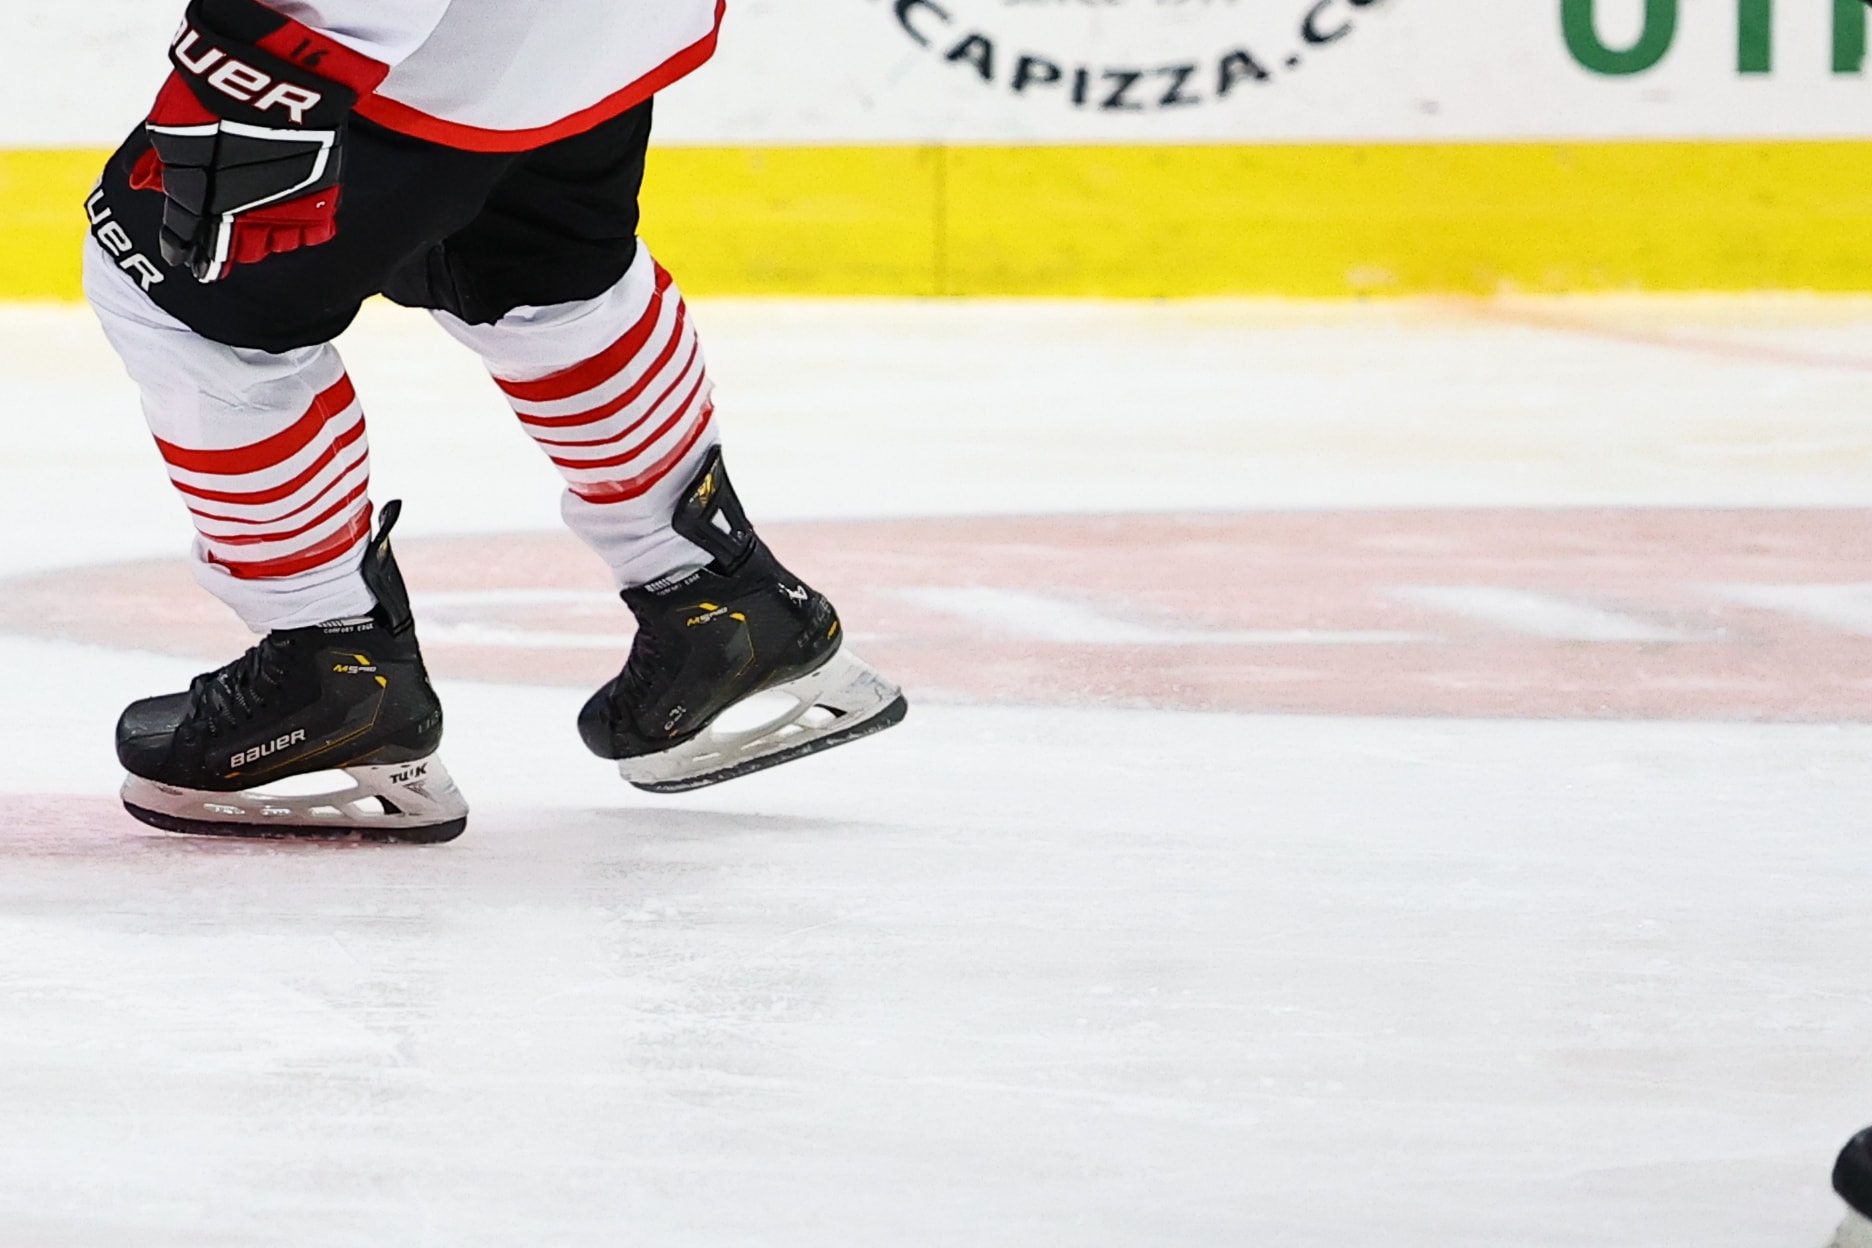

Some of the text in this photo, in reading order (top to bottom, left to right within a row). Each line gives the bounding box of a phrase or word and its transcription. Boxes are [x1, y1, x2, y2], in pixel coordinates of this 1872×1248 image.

[290, 38, 330, 68] 16
[86, 176, 166, 293] UER
[229, 727, 307, 770] BAUER
